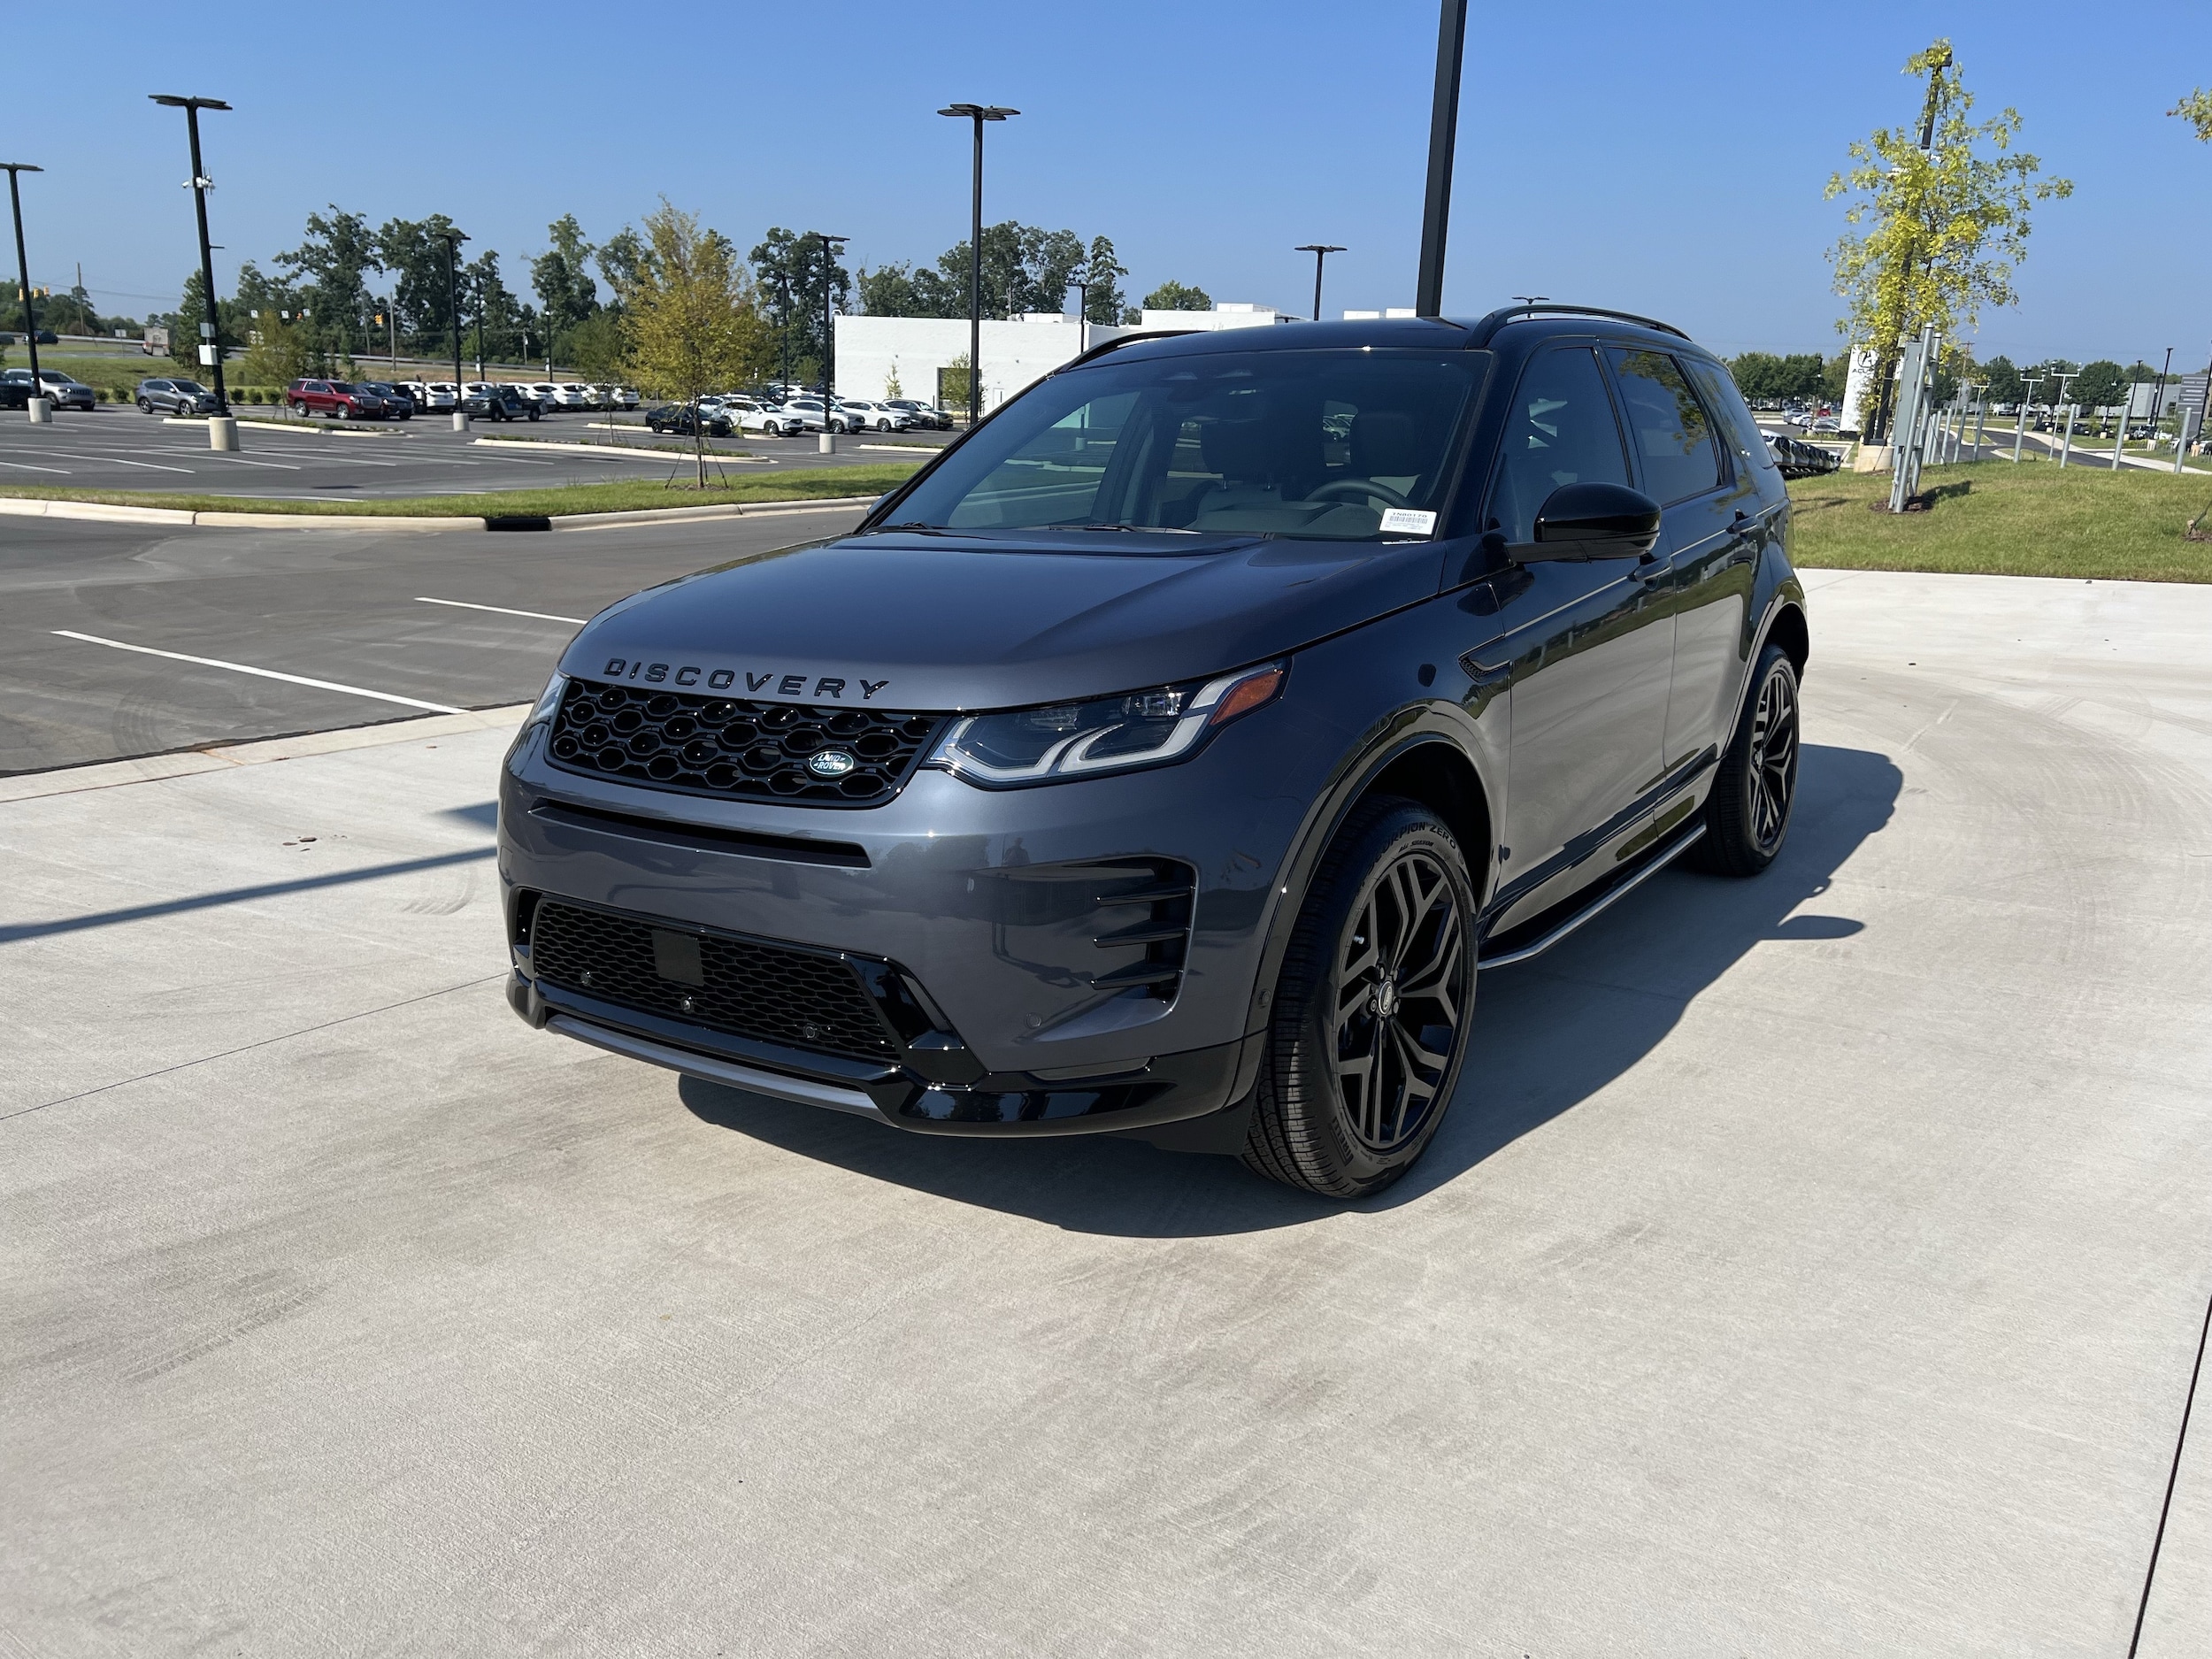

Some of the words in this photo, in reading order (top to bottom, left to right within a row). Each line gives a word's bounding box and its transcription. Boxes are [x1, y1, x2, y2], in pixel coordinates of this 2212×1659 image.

[603, 657, 889, 700] DISCOVERY
[818, 762, 846, 771] ROVER
[1429, 824, 1456, 849] ZERO
[1330, 1116, 1354, 1166] PIRELLI
